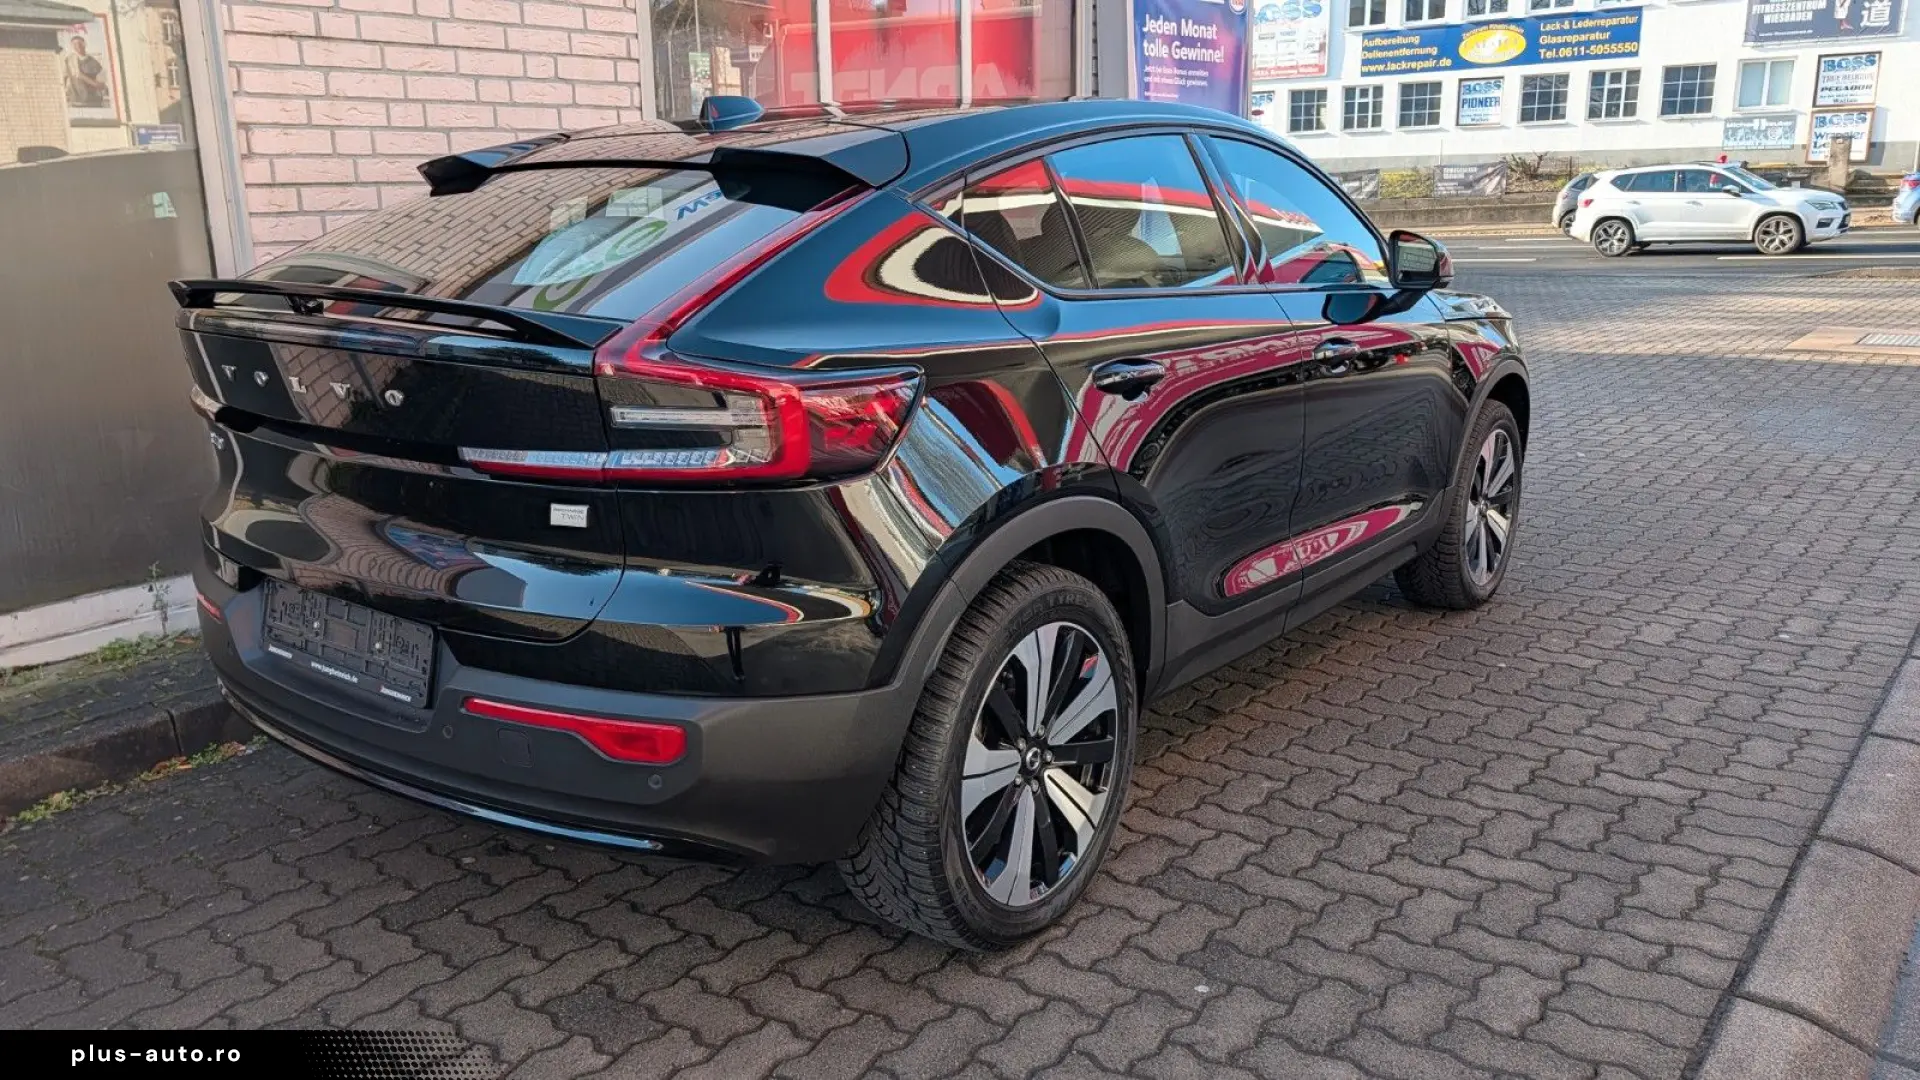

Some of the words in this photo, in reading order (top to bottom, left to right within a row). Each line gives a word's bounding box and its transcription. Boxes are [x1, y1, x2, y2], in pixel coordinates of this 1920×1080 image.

[1572, 15, 1639, 29] Lederreparatur
[1763, 11, 1813, 24] WIESBADEN
[1142, 14, 1178, 36] Jeden
[1181, 18, 1218, 39] Monat
[1362, 35, 1420, 47] Aufbereitung
[1539, 30, 1611, 44] Glasreparatur
[1143, 38, 1169, 58] tolle
[1171, 41, 1225, 63] Gewinne!
[1361, 46, 1438, 59] Dellenentfernung
[1538, 41, 1638, 60] Tel.0611-5055550
[1361, 57, 1453, 73] www.lackrepair.de
[1822, 54, 1877, 73] BOSS
[1462, 80, 1502, 95] BOSS
[1461, 97, 1501, 108] PIONEER
[1814, 112, 1867, 128] BOSS
[221, 364, 405, 407] VOLVO
